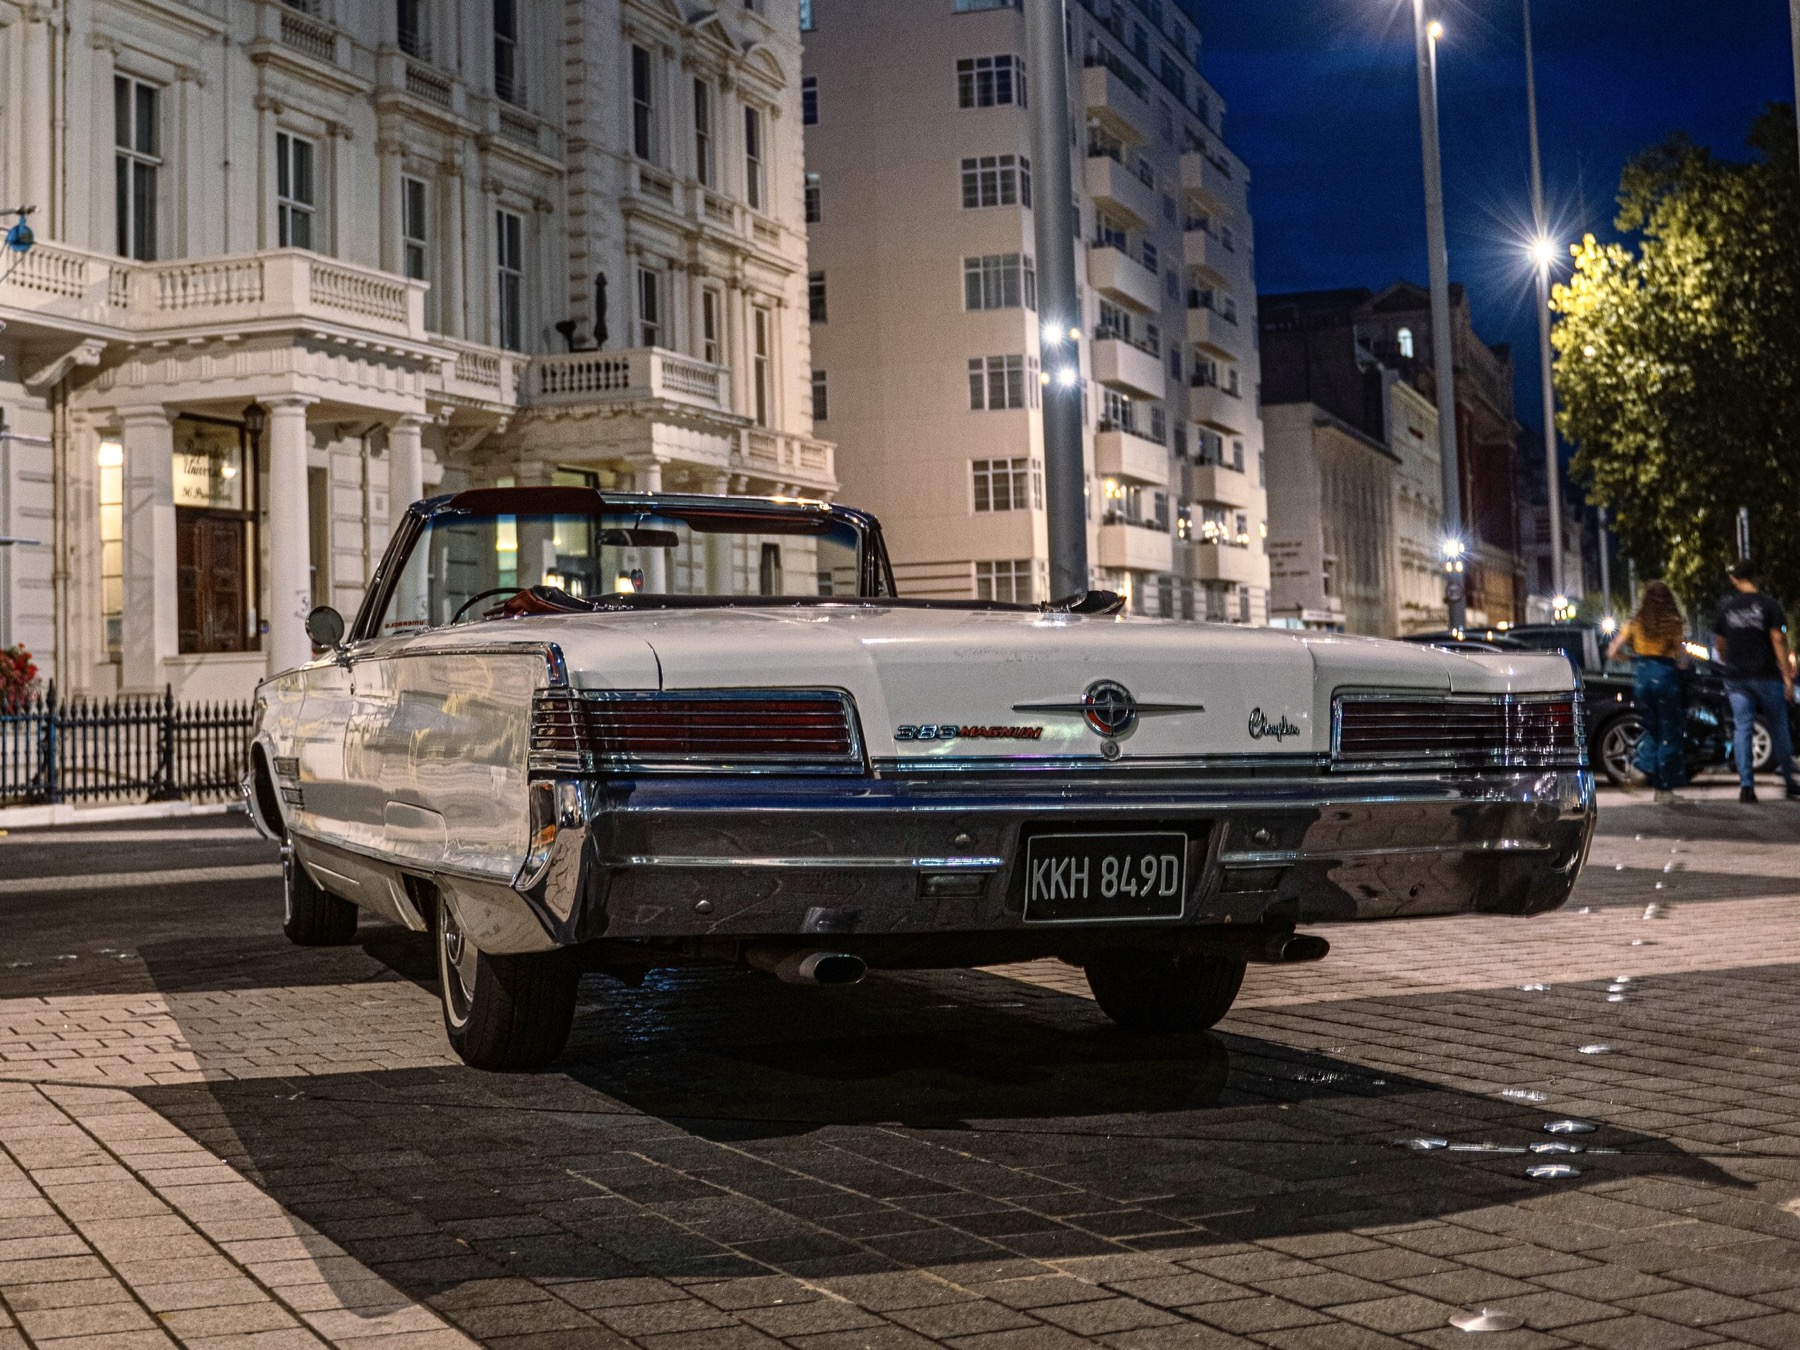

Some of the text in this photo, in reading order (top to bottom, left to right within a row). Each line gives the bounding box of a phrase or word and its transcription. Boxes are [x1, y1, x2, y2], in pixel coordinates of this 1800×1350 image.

[894, 725, 1043, 740] 383 MAGNUM
[1248, 707, 1300, 743] Chrysler
[1032, 855, 1179, 900] KKH 849D
